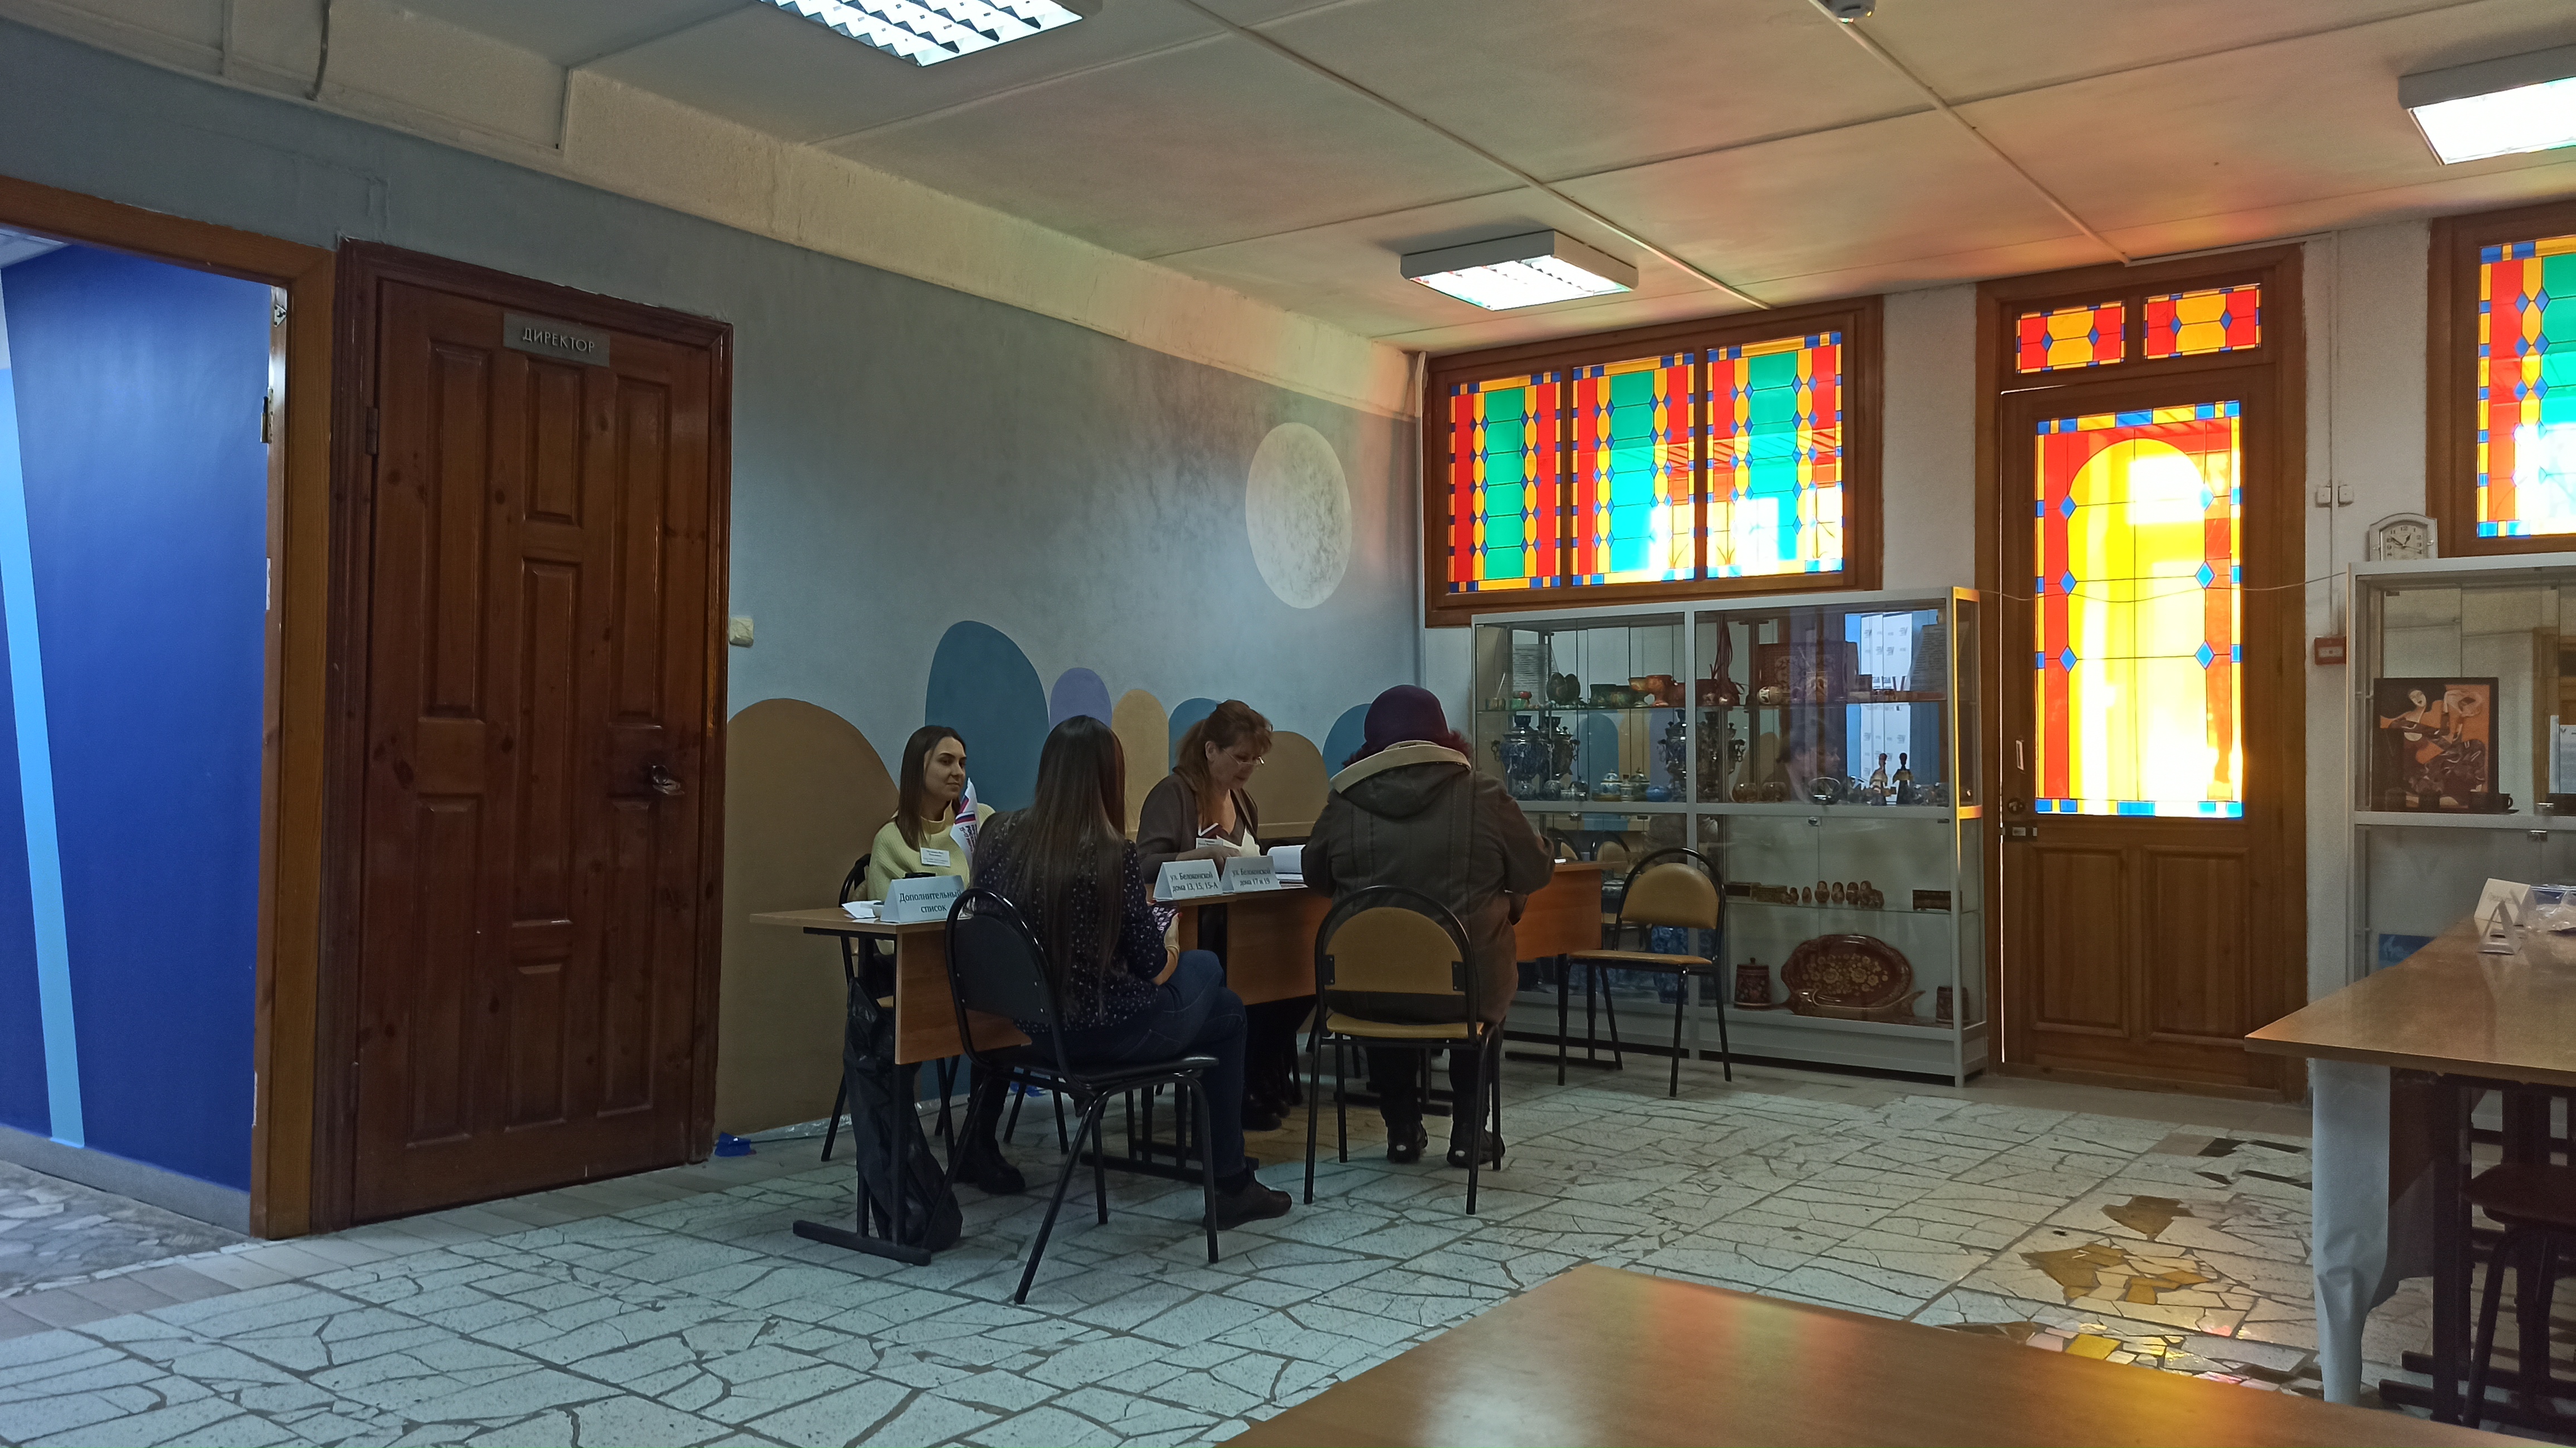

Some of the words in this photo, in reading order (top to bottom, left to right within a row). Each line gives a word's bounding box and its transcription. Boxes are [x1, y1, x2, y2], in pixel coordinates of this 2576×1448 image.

[523, 327, 594, 353] ДИРЕКТОР
[900, 889, 961, 903] Дополнительный
[920, 904, 947, 913] список
